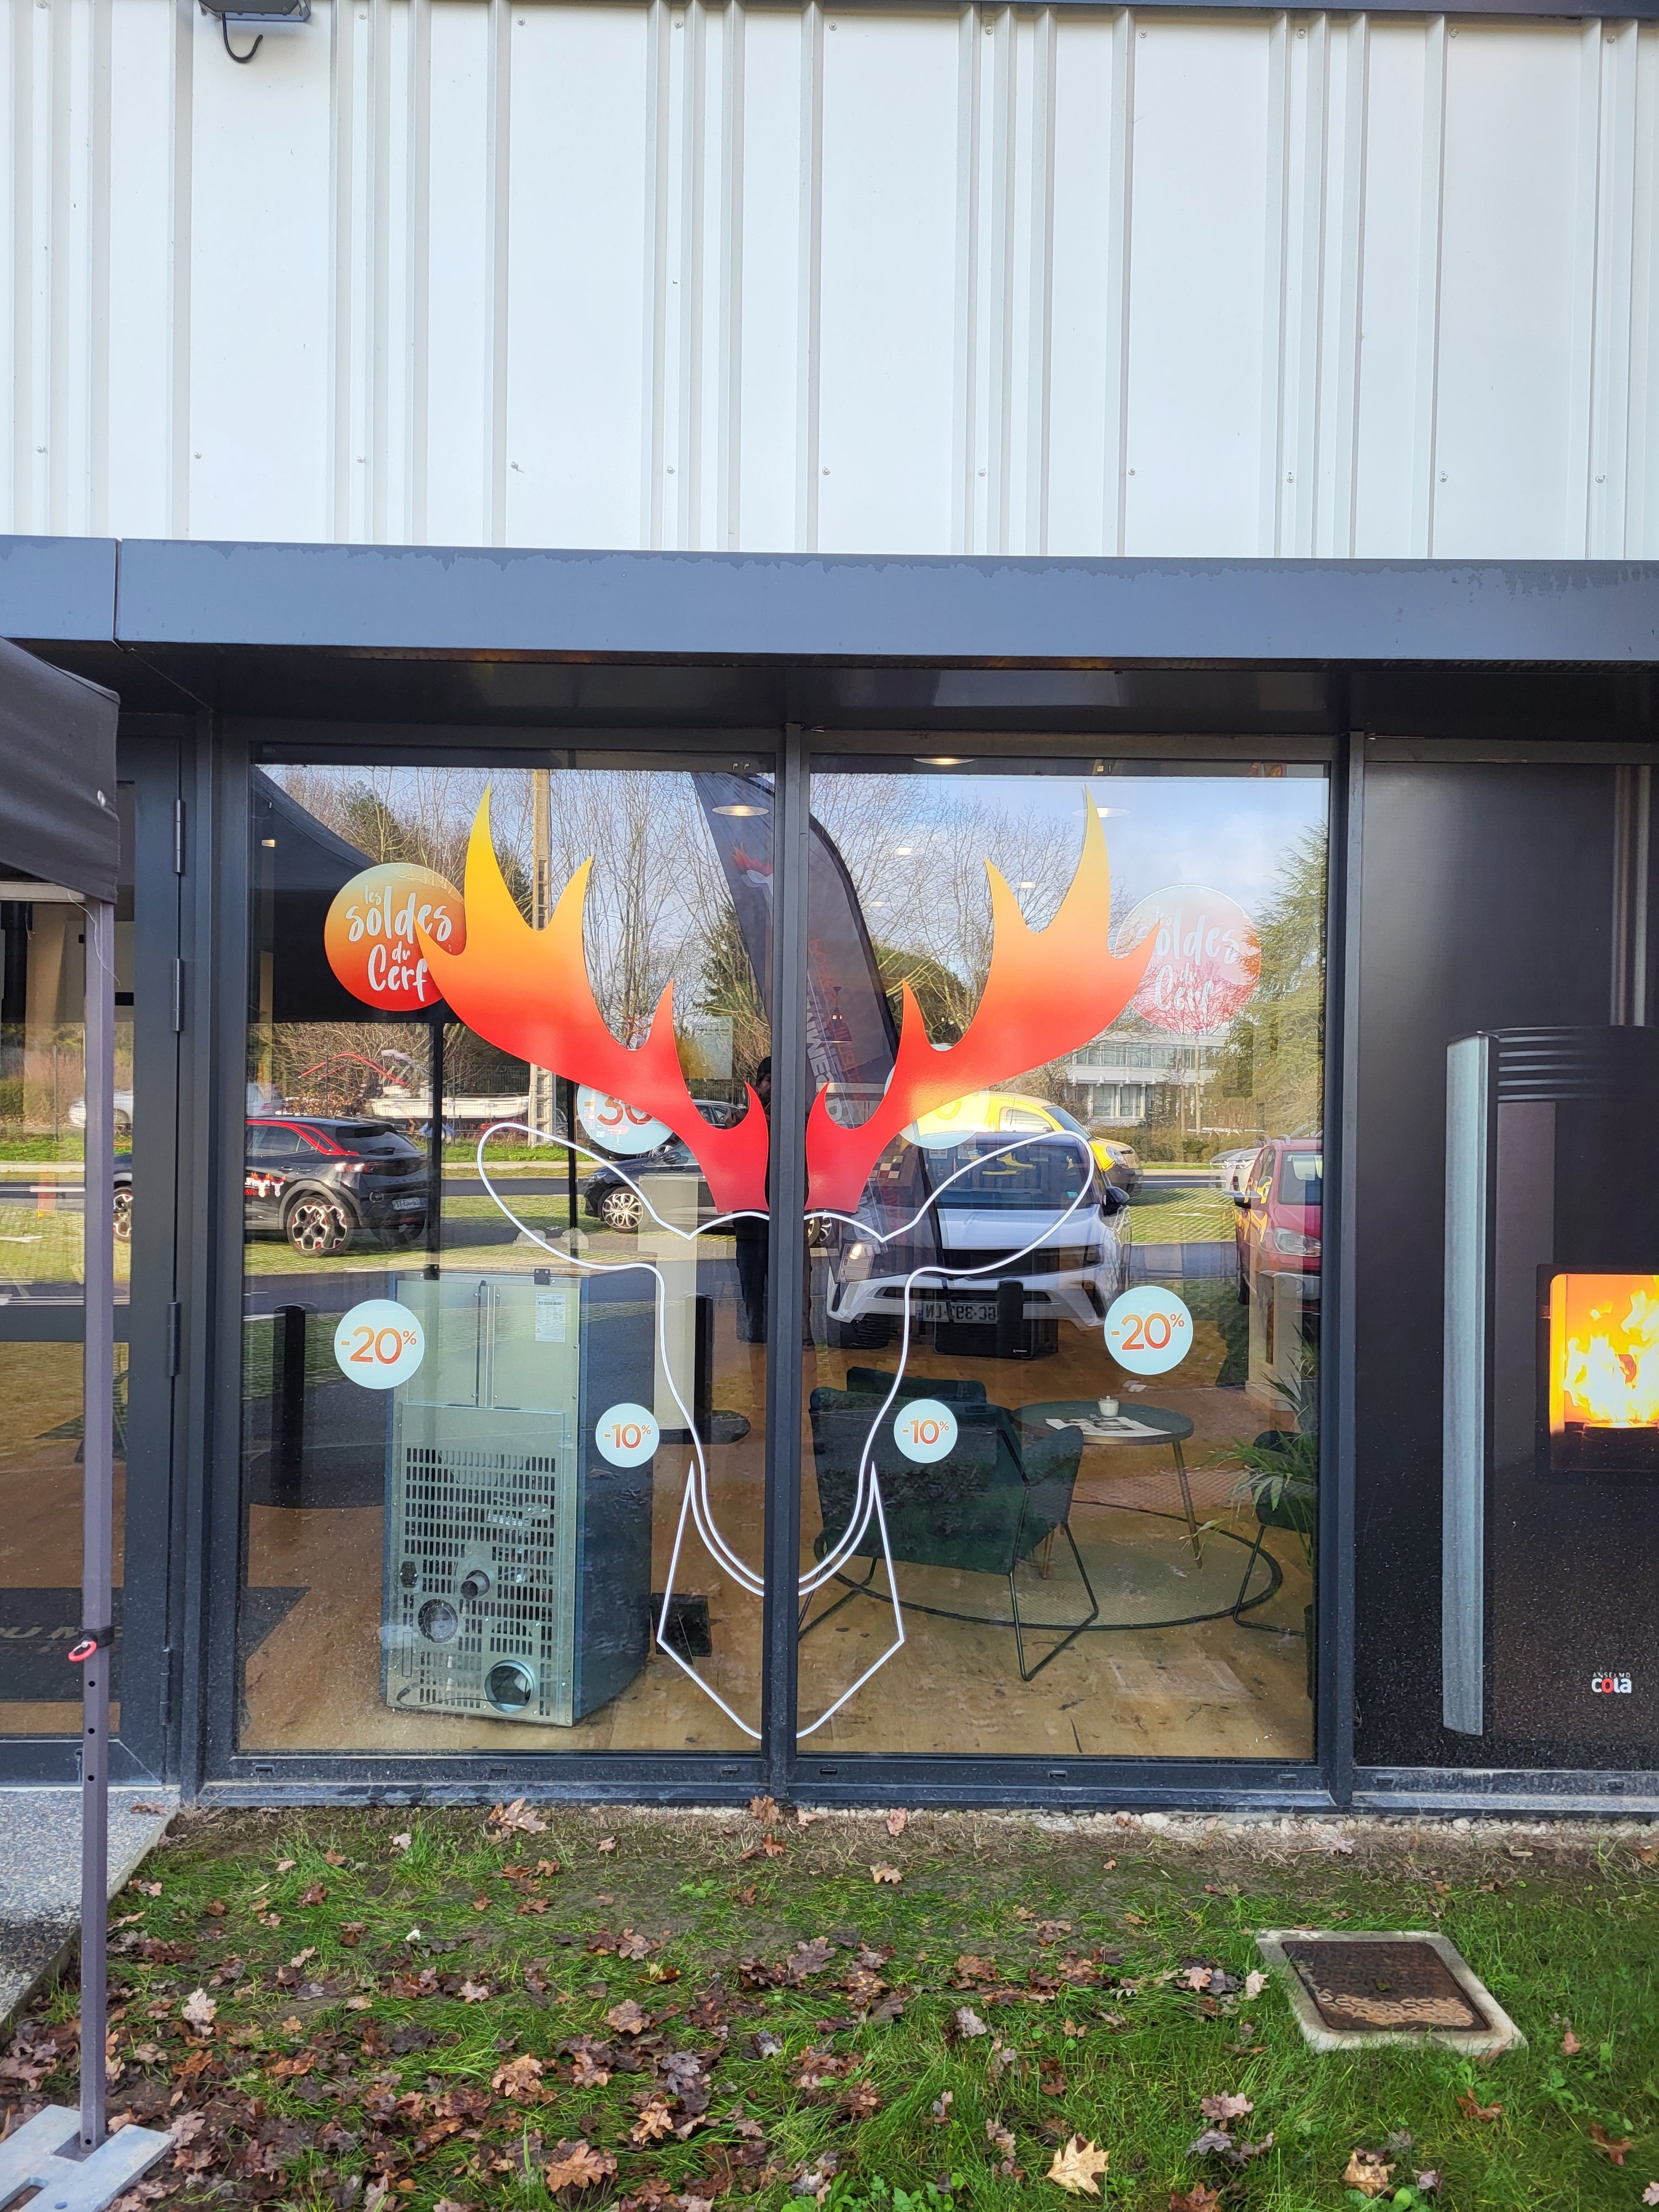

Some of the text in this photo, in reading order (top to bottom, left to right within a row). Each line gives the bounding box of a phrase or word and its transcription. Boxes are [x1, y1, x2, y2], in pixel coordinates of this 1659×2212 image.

[364, 885, 382, 905] les
[345, 885, 452, 944] soldes
[392, 941, 410, 963] du
[1135, 907, 1240, 966] oldes
[368, 944, 428, 1001] Cerf
[1155, 964, 1214, 1023] Cerf
[341, 1326, 417, 1364] -20%
[1111, 1312, 1185, 1350] -20%
[604, 1423, 651, 1449] -10%
[902, 1420, 950, 1444] -10%
